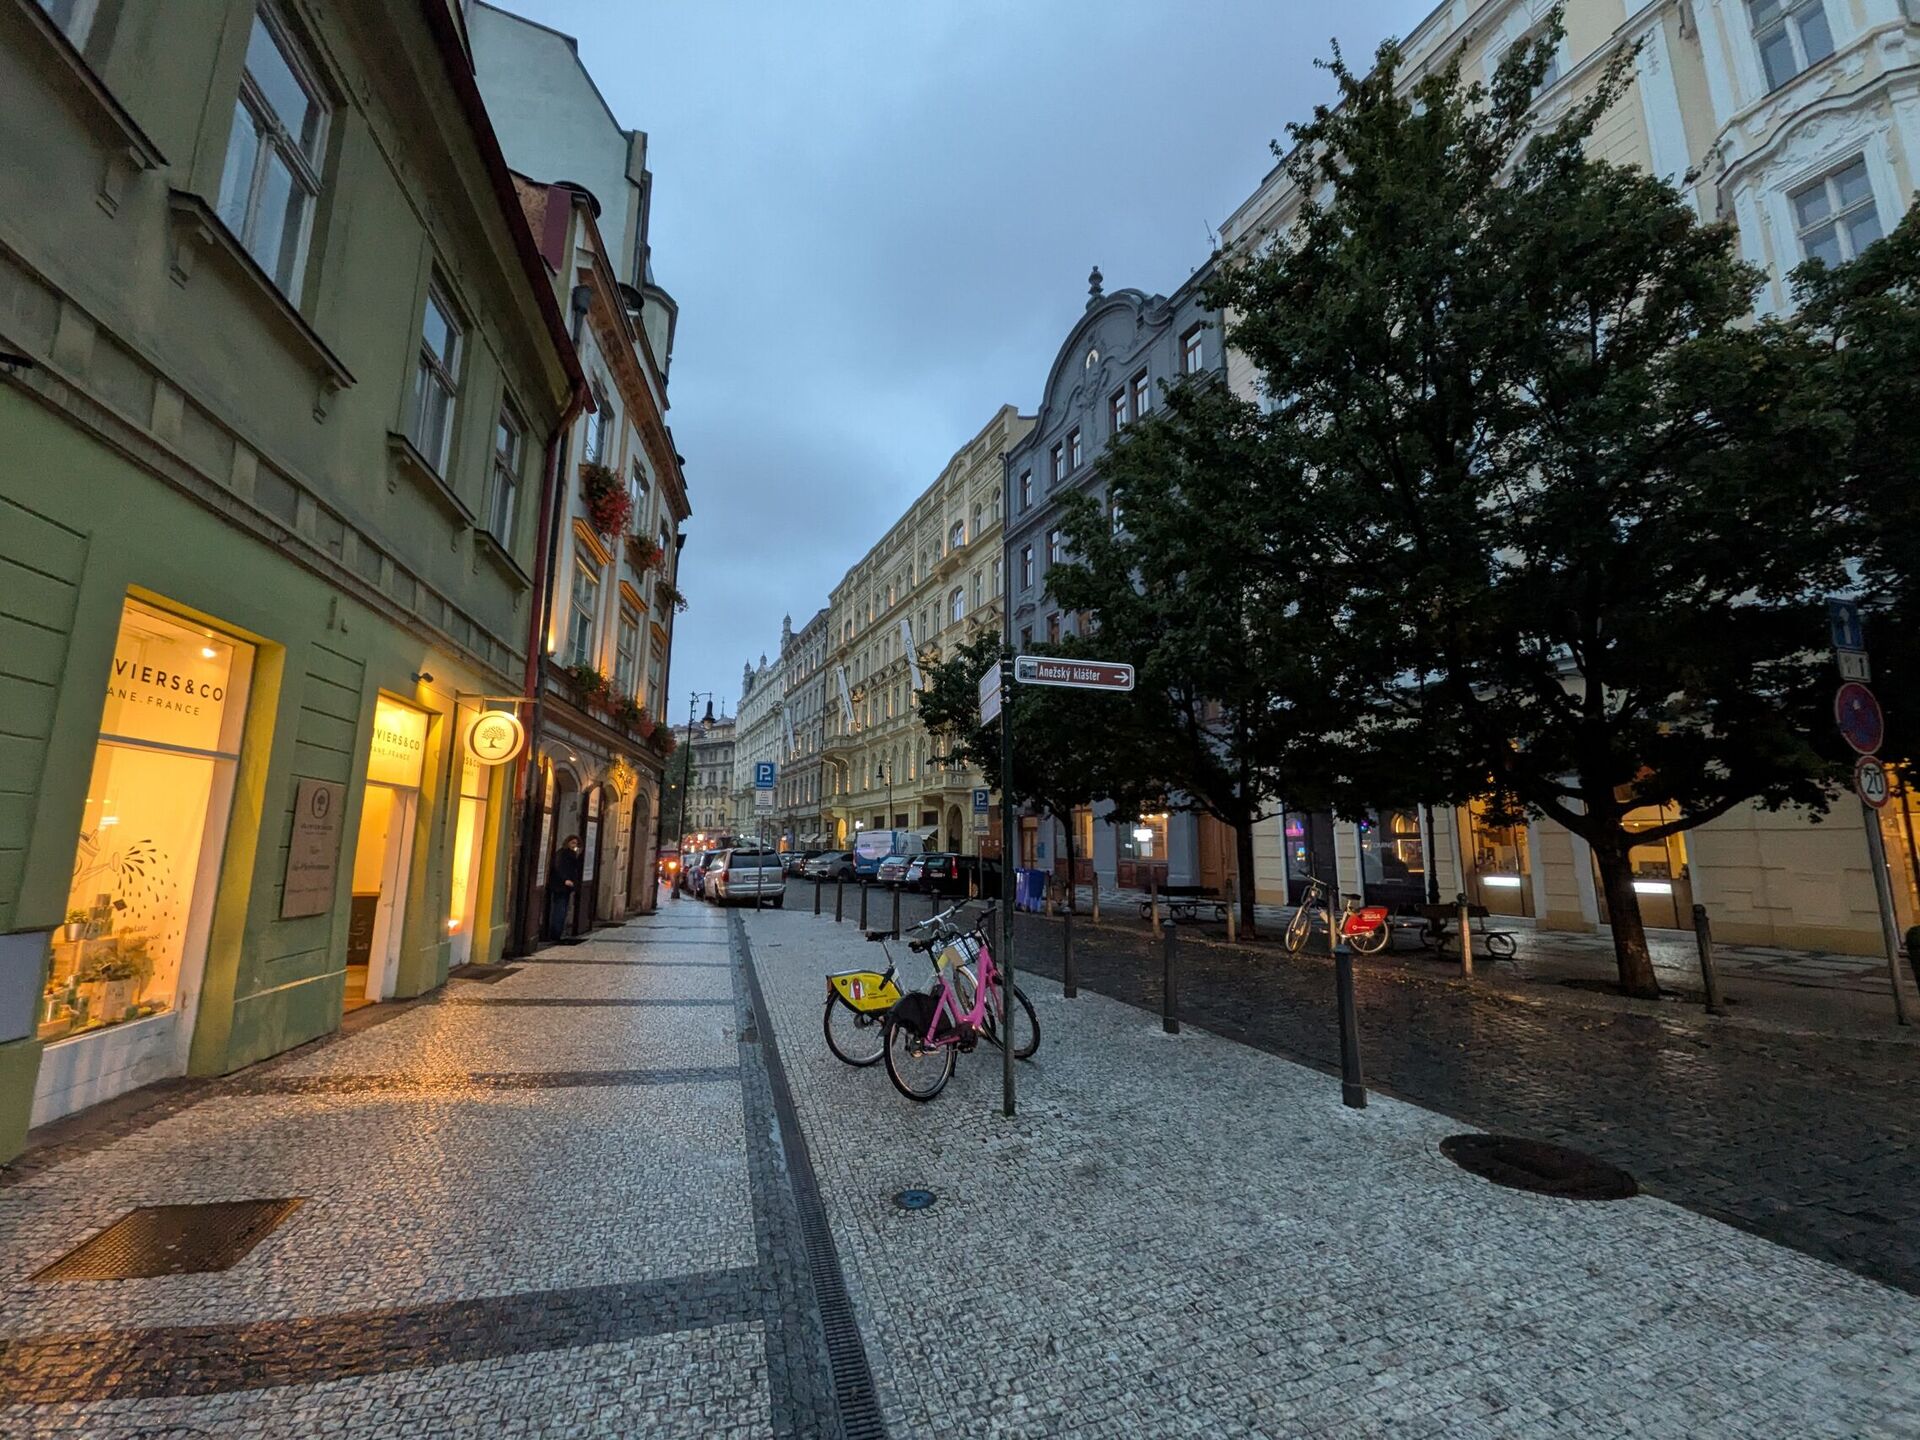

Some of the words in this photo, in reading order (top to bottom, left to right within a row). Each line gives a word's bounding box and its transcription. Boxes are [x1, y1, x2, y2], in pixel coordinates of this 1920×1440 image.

[115, 658, 224, 702] VIERS&CO
[1038, 664, 1071, 682] Anežský
[1073, 666, 1101, 681] klášter
